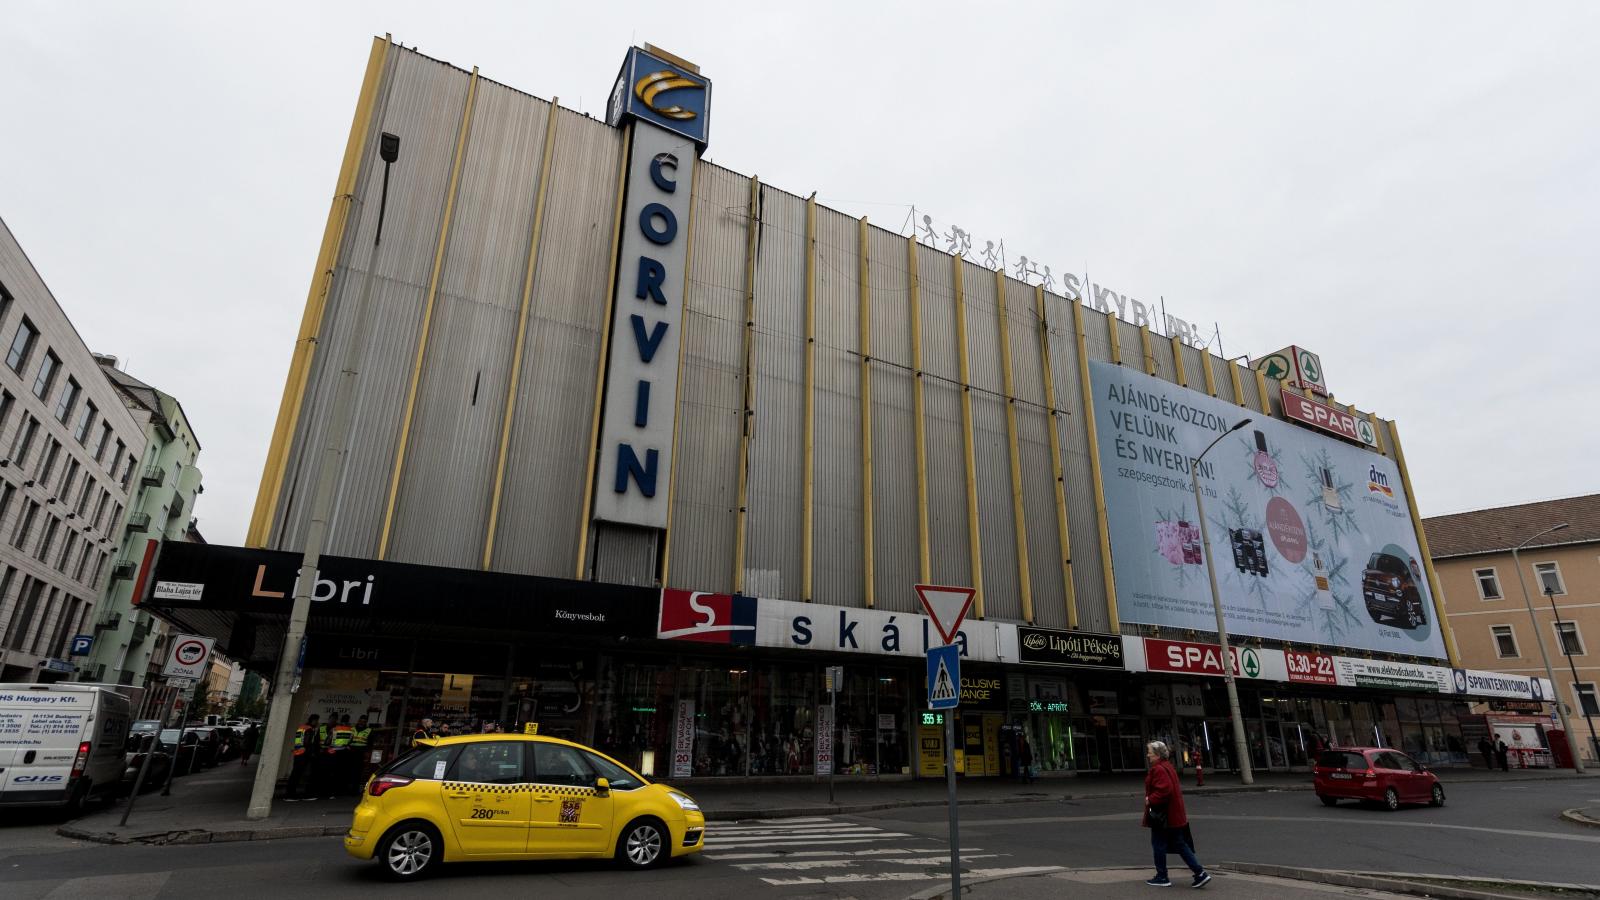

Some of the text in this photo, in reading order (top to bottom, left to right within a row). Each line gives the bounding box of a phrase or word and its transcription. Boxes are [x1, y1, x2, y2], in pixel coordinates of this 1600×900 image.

[614, 151, 680, 499] CORVIN
[1107, 383, 1228, 433] AJÁNDÉKOZZON
[1300, 400, 1356, 435] SPAR
[1109, 410, 1179, 445] VELÜNK
[1115, 434, 1138, 461] ÉS
[1369, 464, 1388, 487] dm
[251, 564, 375, 605] Libri
[555, 609, 605, 622] Könyvesbolt
[74, 640, 89, 652] P
[1049, 635, 1120, 658] Lipóti Pékség
[1167, 646, 1239, 671] SPAR
[960, 677, 1001, 689] CLUSIVE
[1467, 676, 1531, 693] SPRINTERNYOMDA
[16, 695, 58, 703] Hungary
[959, 689, 992, 700] HANGE
[676, 754, 689, 763] 20
[819, 754, 829, 762] 20
[14, 775, 63, 783] CHS
[471, 808, 494, 819] 280
